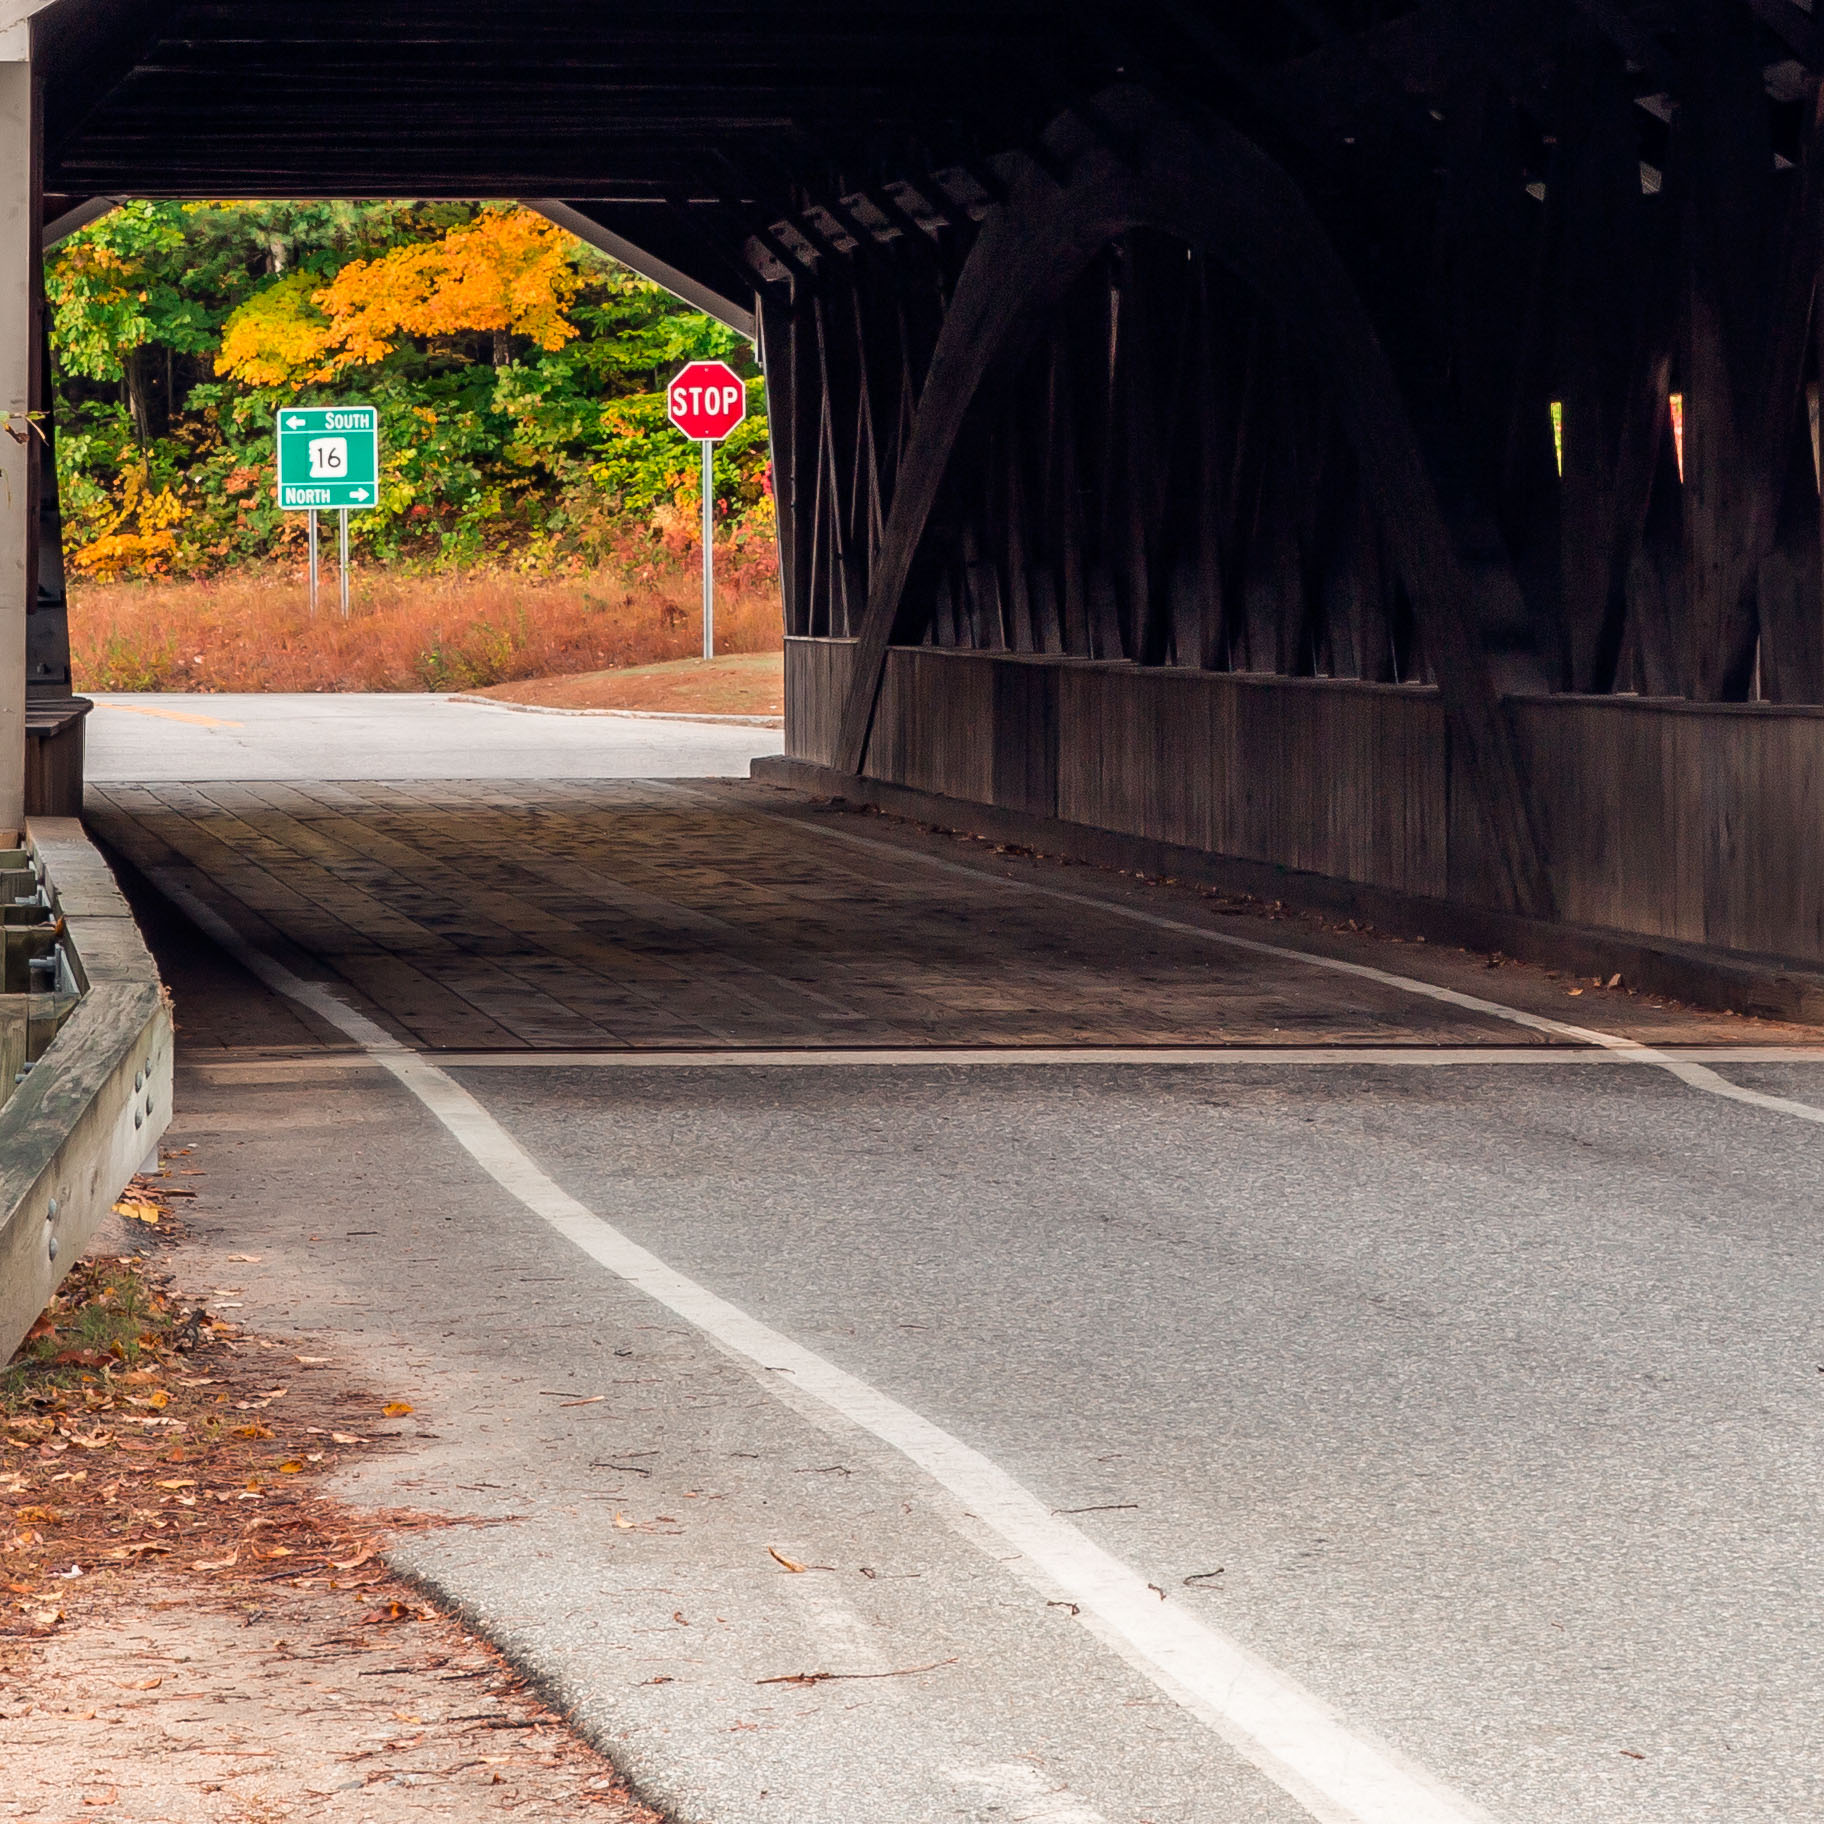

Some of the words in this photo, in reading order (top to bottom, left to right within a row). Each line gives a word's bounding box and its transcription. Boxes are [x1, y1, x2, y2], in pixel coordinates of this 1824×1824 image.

[673, 386, 738, 416] STOP
[325, 412, 369, 429] SOUTH
[318, 448, 341, 468] 16
[285, 487, 330, 504] NORTH
